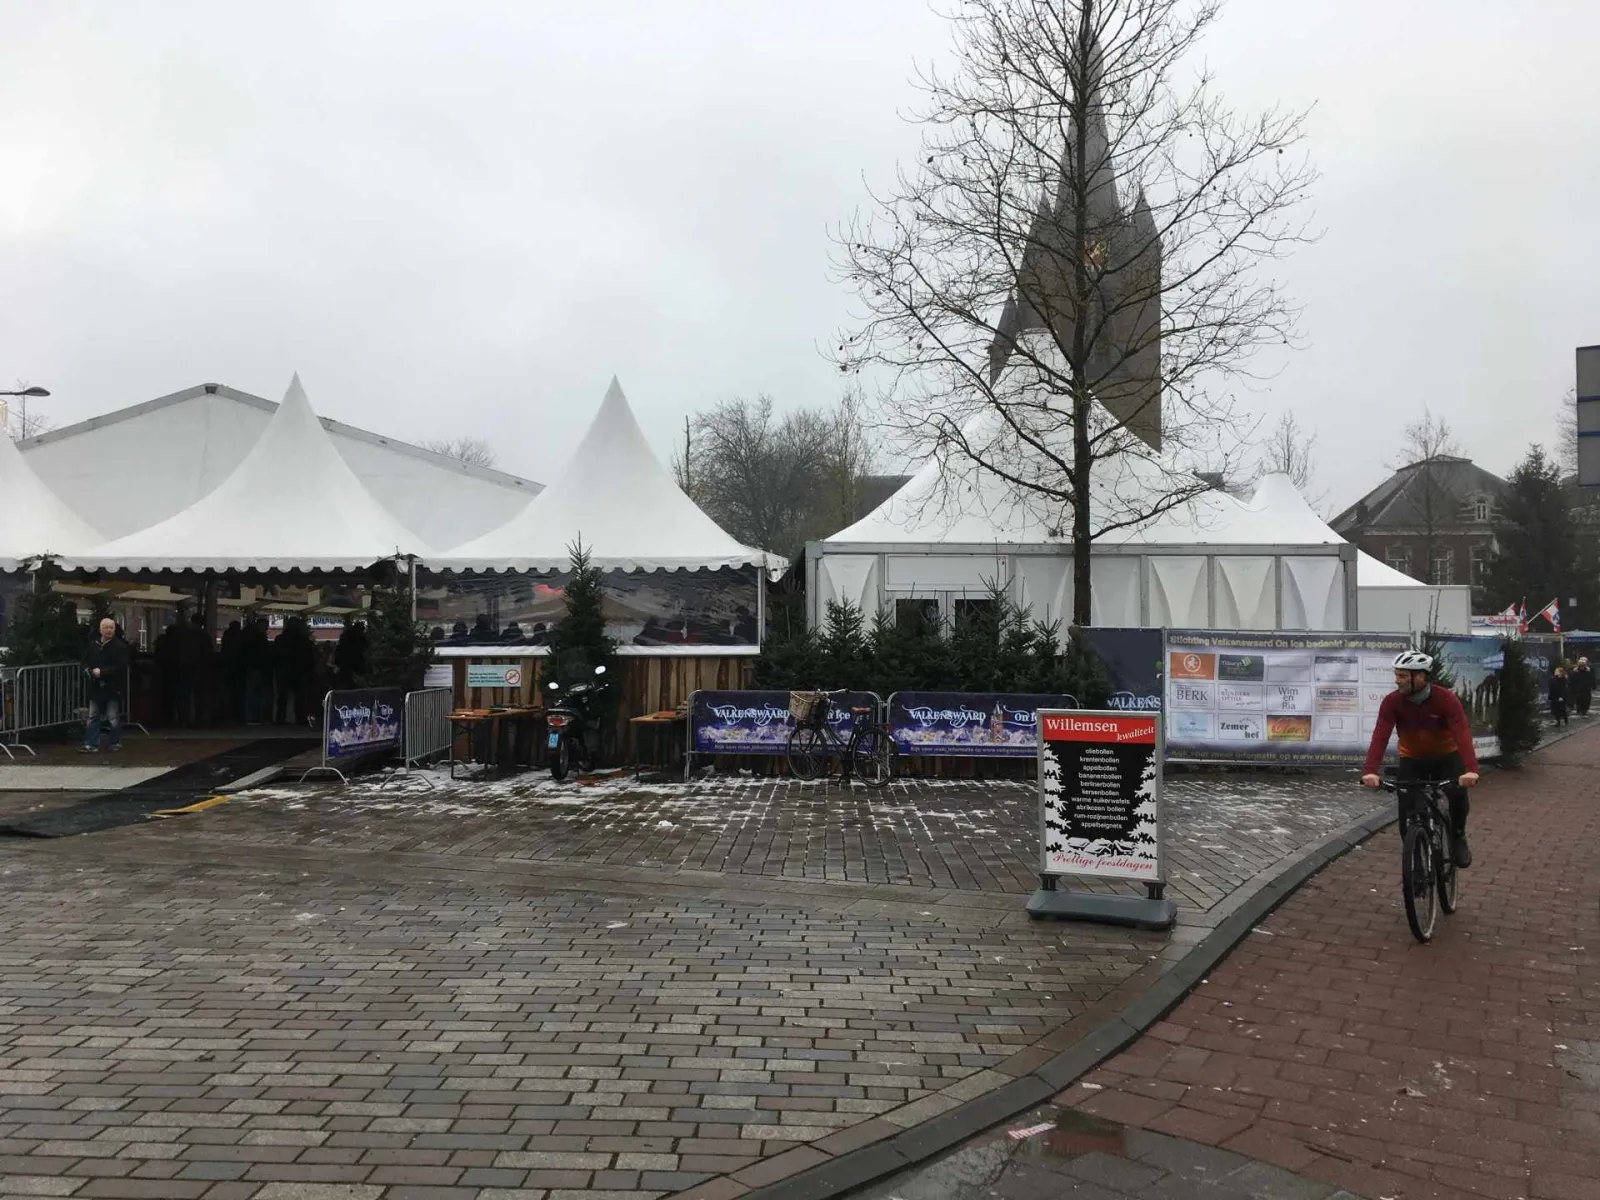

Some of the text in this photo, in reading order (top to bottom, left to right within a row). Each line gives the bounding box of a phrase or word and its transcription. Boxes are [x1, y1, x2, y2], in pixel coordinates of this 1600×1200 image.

[1170, 636, 1210, 647] Stichting
[1212, 638, 1273, 648] Valkenswaard
[1275, 640, 1288, 648] On
[1290, 640, 1304, 648] Ice
[1366, 640, 1407, 650] sponsors
[1177, 689, 1208, 701] BERK
[1278, 687, 1299, 696] Wim
[1282, 702, 1296, 710] Ria
[710, 705, 790, 723] VALKENSWAARD
[905, 707, 986, 724] VALKENSWAARD
[1046, 719, 1155, 742] Willemsen kwaliteit
[1220, 722, 1249, 731] Zemer
[1078, 772, 1122, 780] bananenbollen
[1053, 852, 1153, 872] Prettige feestdagen
